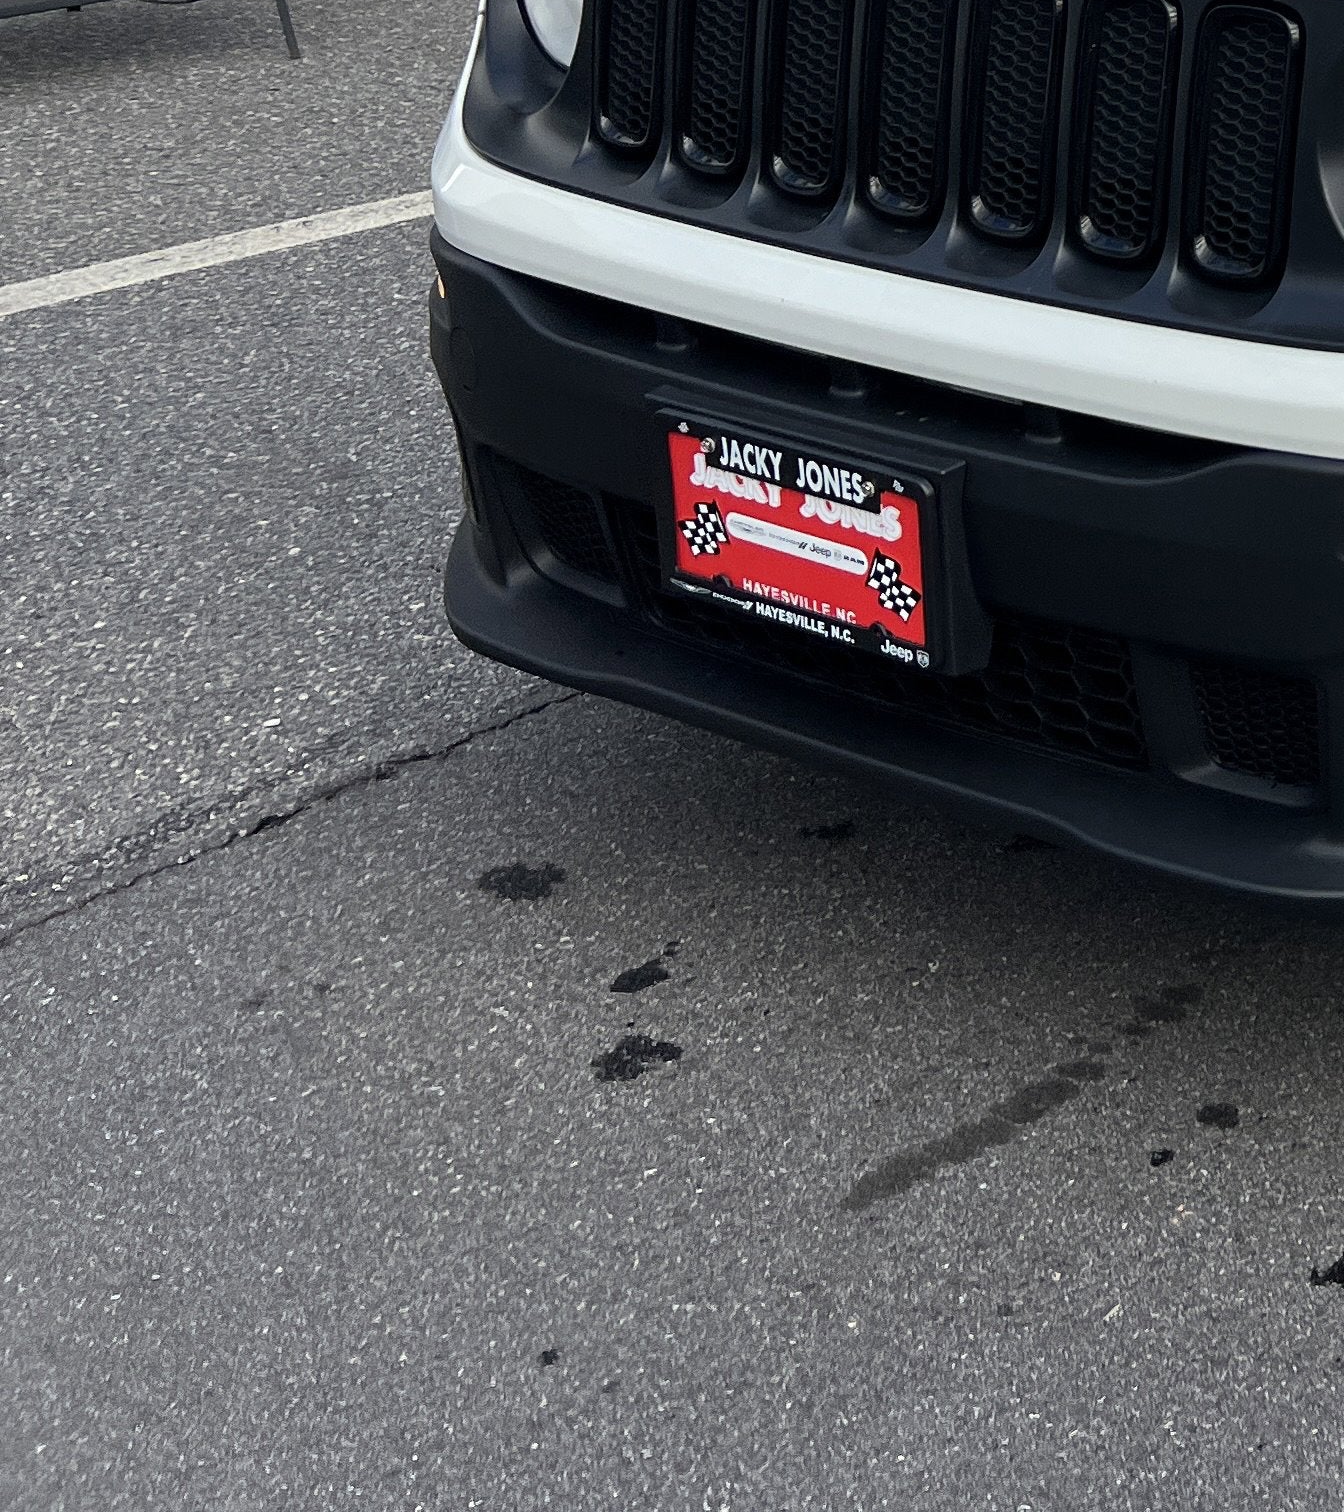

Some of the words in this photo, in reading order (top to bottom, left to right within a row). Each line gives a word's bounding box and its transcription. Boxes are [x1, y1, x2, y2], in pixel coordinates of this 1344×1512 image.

[719, 436, 783, 481] JACKY
[796, 457, 866, 504] JONES
[755, 600, 829, 638] HAYESVILLE,
[830, 625, 856, 644] N.C.
[880, 639, 914, 663] Jeep
